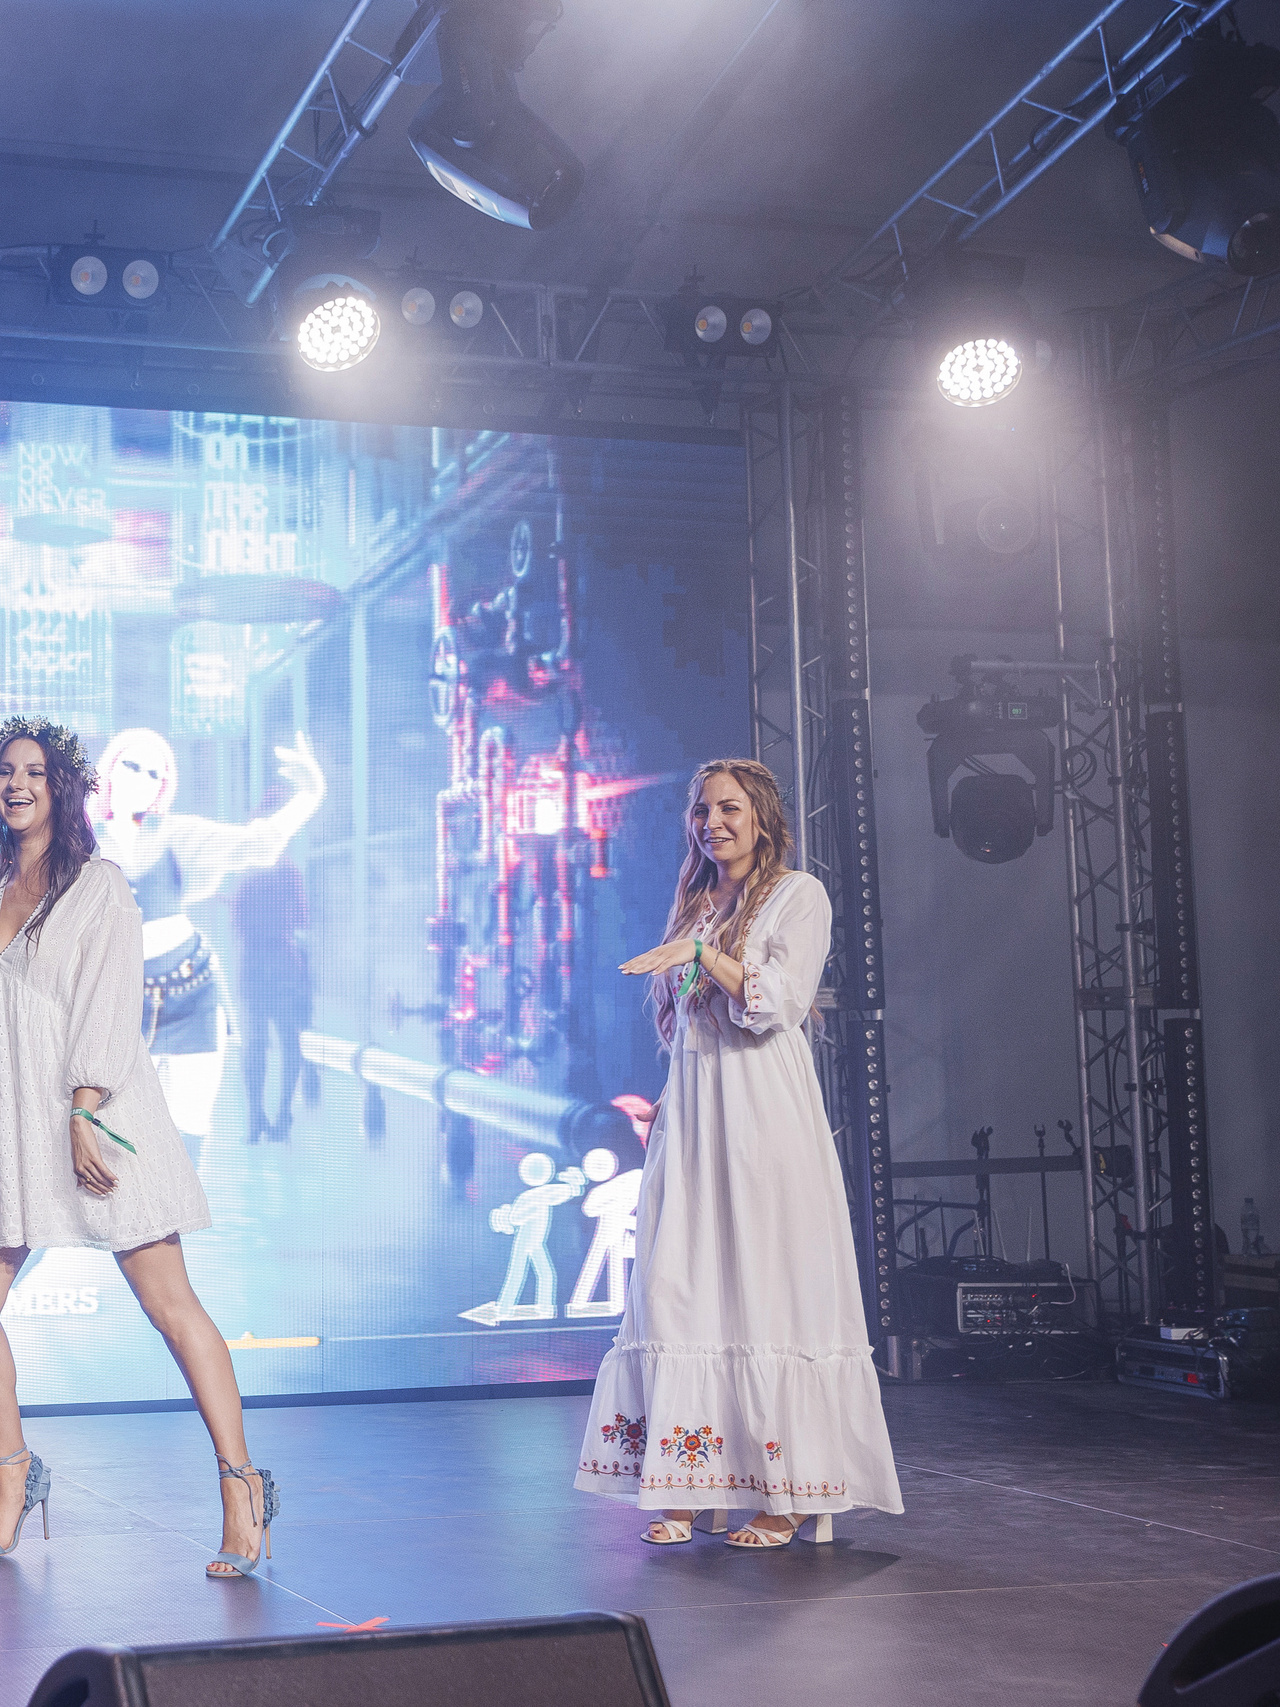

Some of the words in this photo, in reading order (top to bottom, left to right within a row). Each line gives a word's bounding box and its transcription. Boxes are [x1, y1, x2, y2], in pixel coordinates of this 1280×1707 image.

[18, 442, 87, 466] NOW
[18, 465, 54, 486] OR
[18, 485, 107, 514] NEVER
